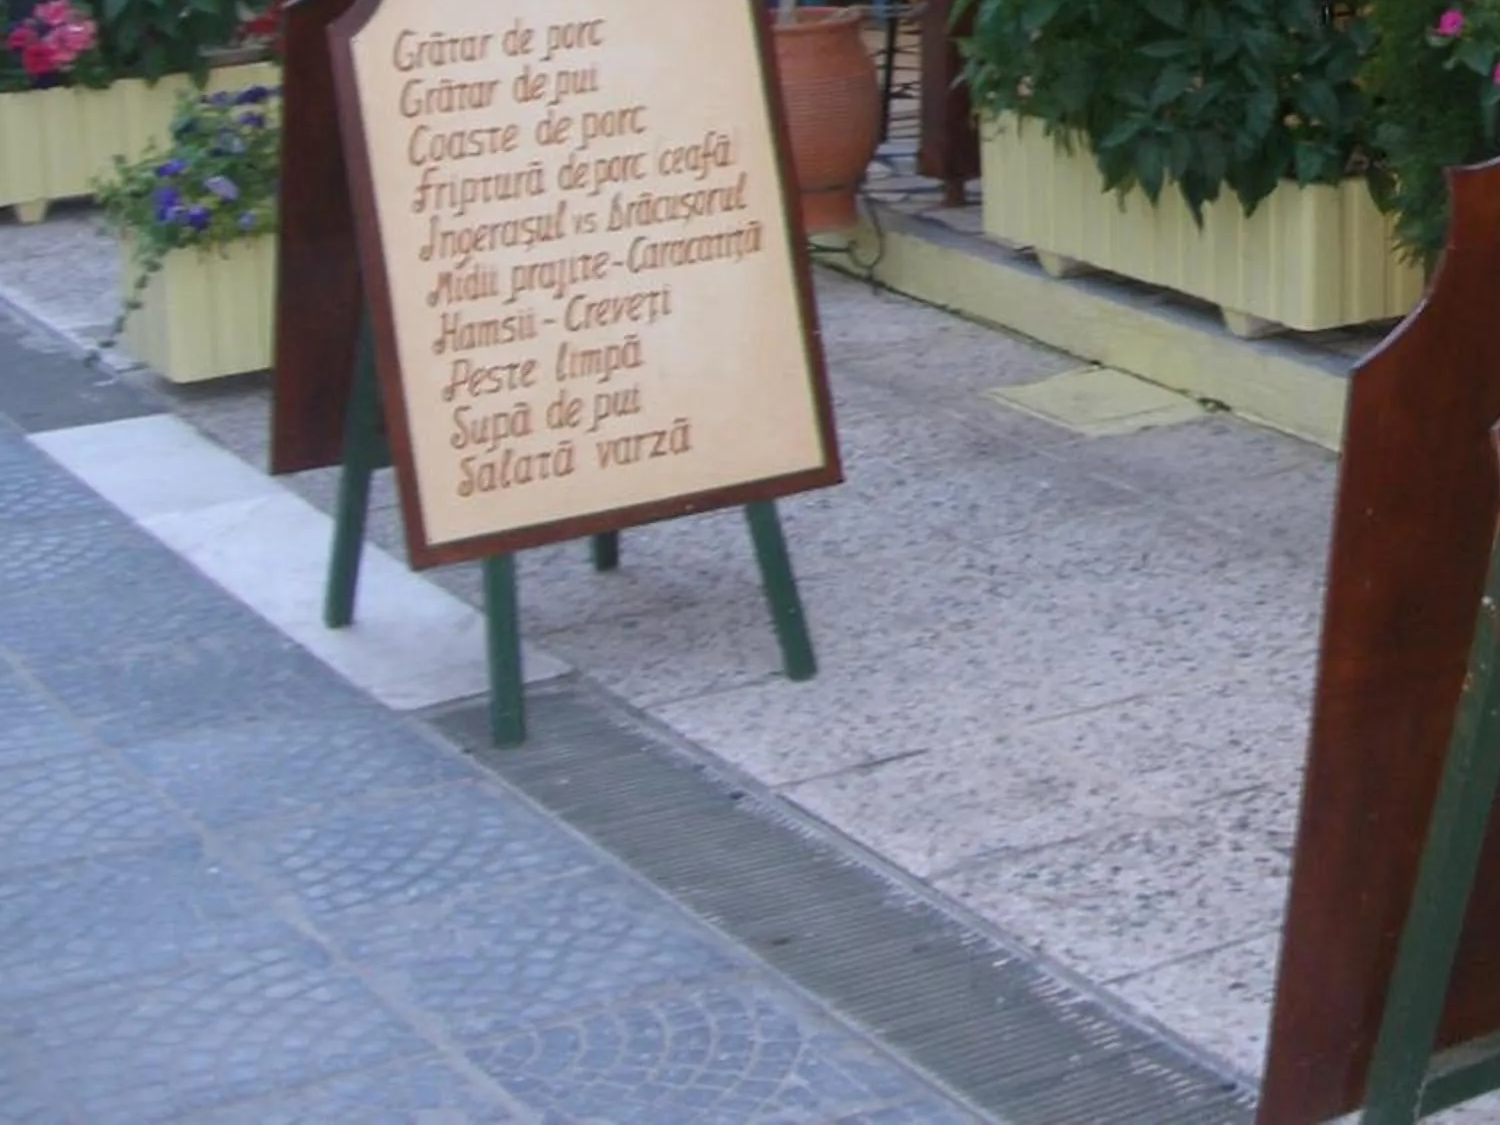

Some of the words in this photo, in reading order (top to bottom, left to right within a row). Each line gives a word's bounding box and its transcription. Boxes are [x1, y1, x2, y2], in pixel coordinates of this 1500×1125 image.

[502, 17, 535, 57] de
[539, 19, 606, 62] porc
[512, 63, 548, 103] de
[547, 67, 600, 106] pui
[407, 124, 519, 167] Coaste
[535, 110, 574, 146] de
[574, 105, 648, 151] porc
[557, 151, 589, 191] de
[587, 152, 647, 196] porc
[573, 211, 598, 236] vs
[442, 358, 538, 403] Peste
[546, 389, 583, 430] de
[585, 384, 642, 433] pui
